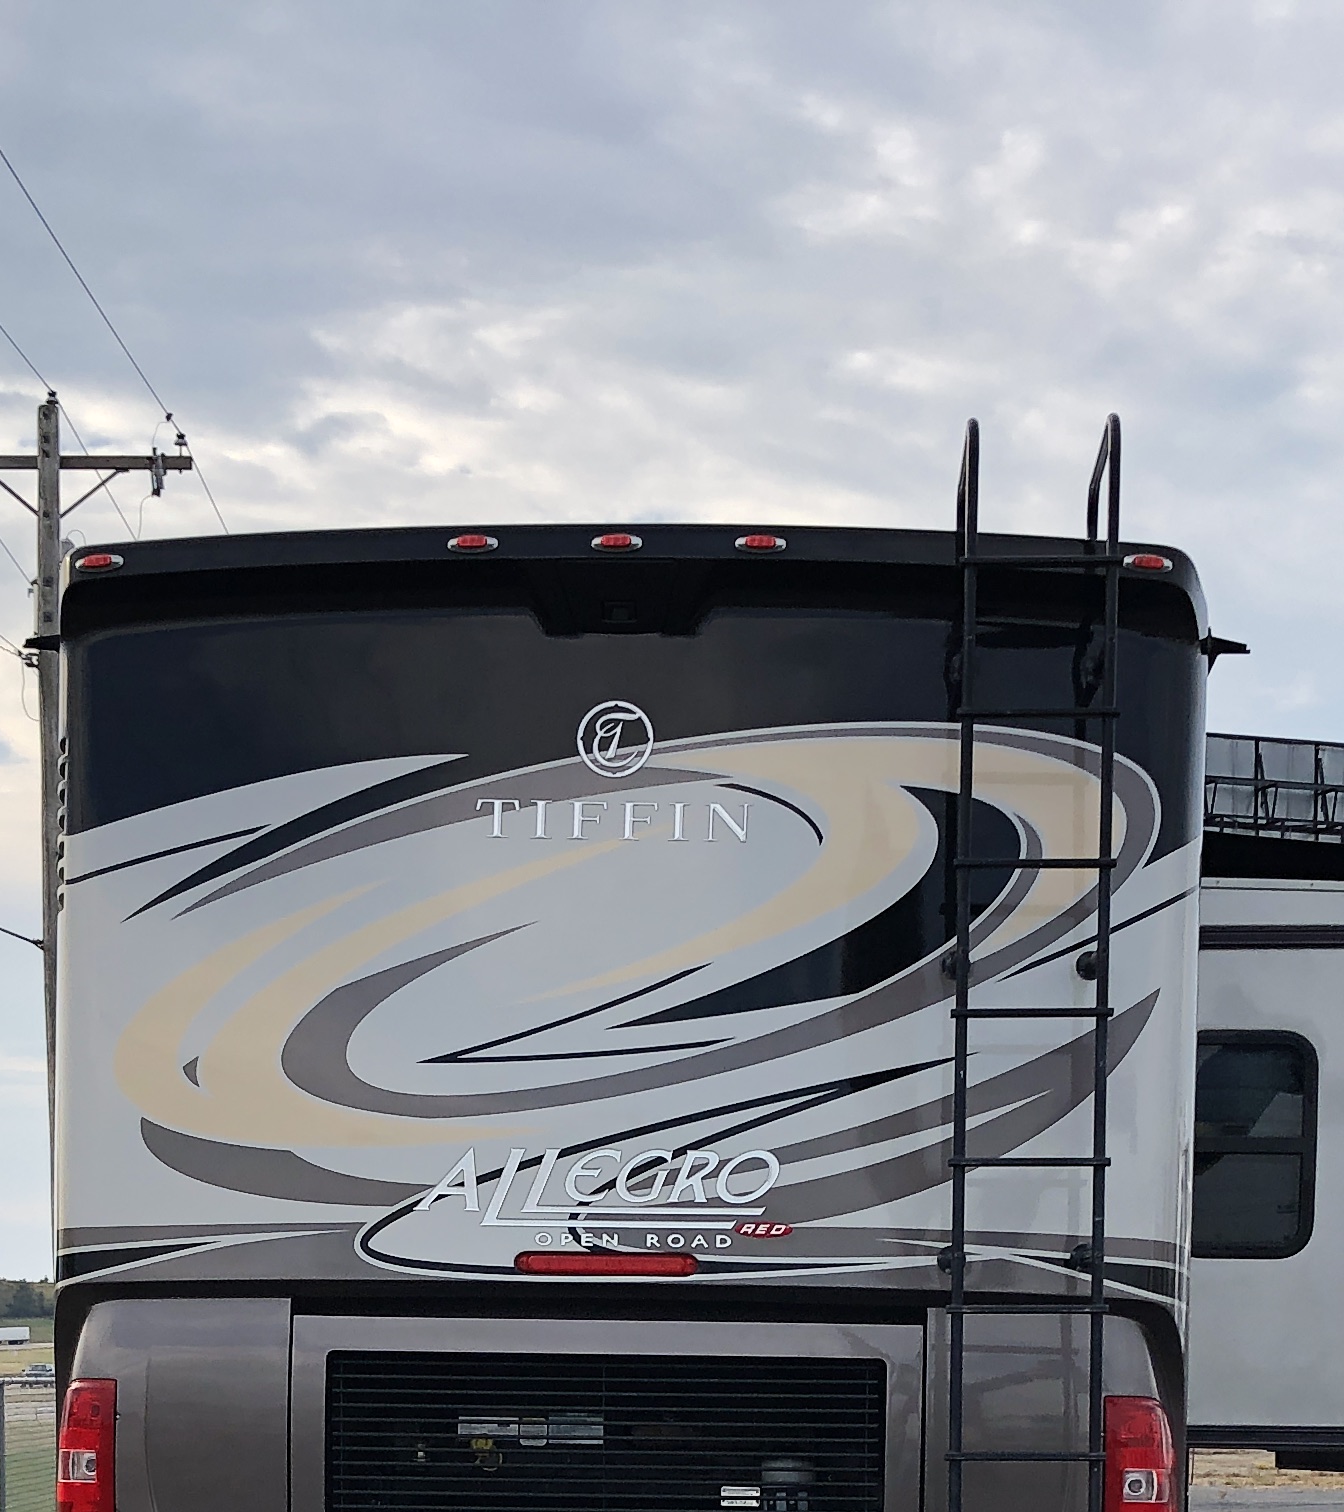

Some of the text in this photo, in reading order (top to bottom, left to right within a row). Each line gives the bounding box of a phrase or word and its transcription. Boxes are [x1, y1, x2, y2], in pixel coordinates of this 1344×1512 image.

[475, 798, 752, 843] TIFFIN
[412, 1146, 780, 1229] ALLEGRO
[534, 1231, 733, 1249] OPEN ROAD
[739, 1222, 788, 1236] RED
